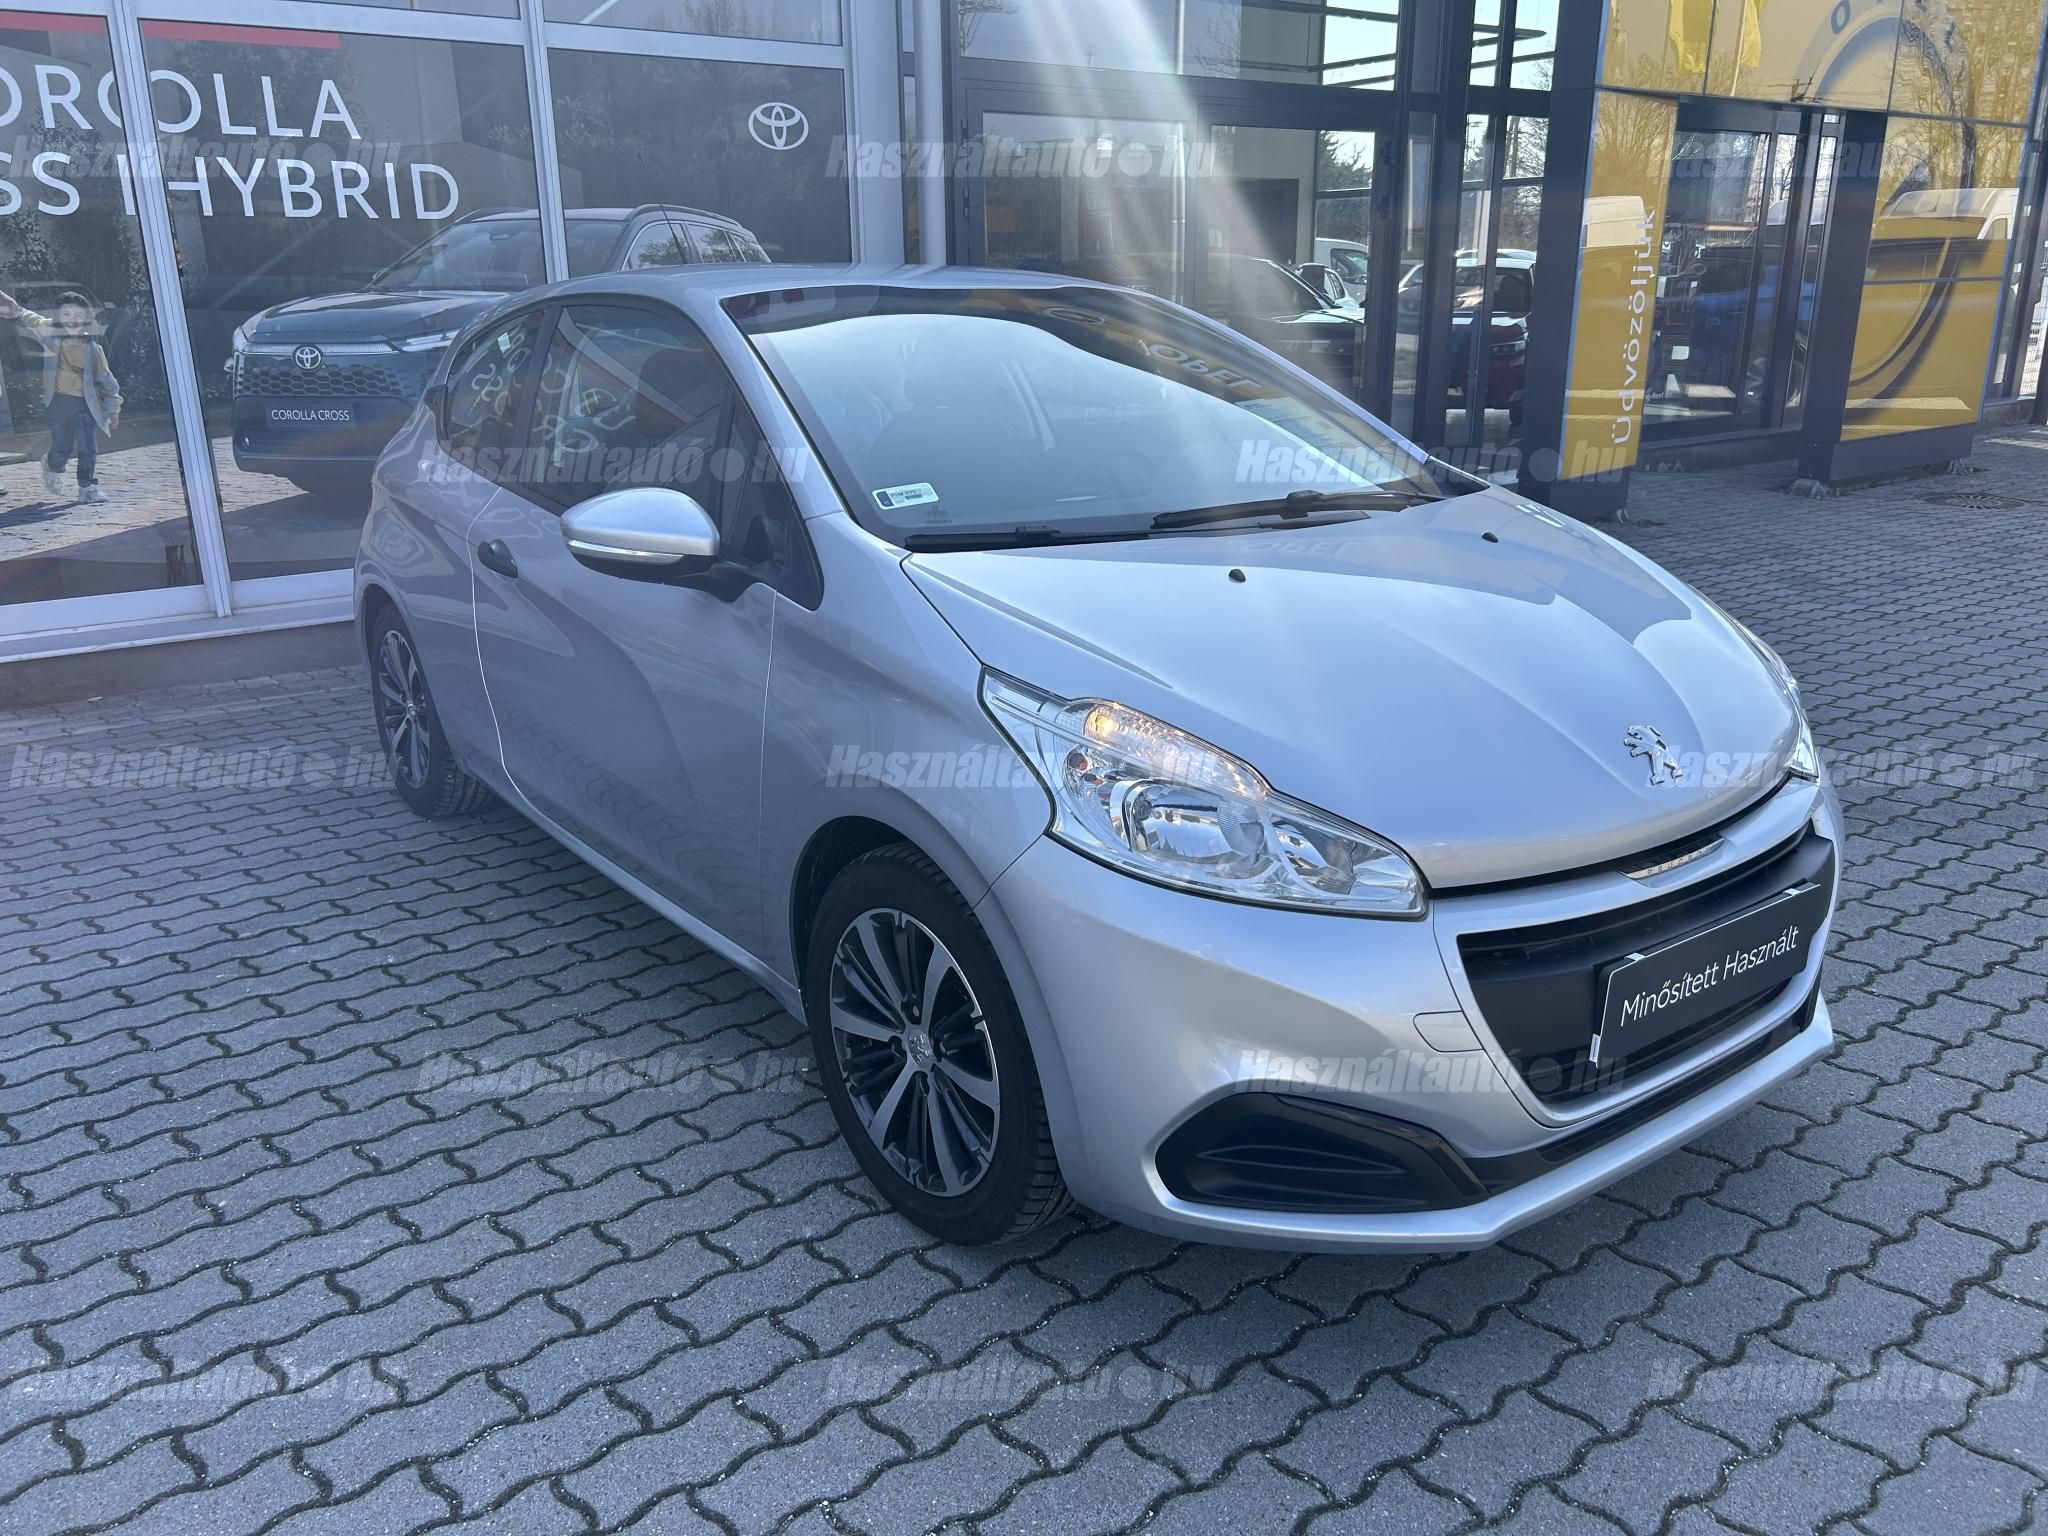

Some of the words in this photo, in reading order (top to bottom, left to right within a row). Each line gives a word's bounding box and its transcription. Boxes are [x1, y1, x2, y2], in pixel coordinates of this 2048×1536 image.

[1611, 208, 1656, 444] Üdvözöljük
[271, 409, 318, 421] COROLLA
[318, 410, 350, 421] CROSS
[1620, 962, 1719, 1027] Minősített
[1723, 925, 1799, 980] Használt
